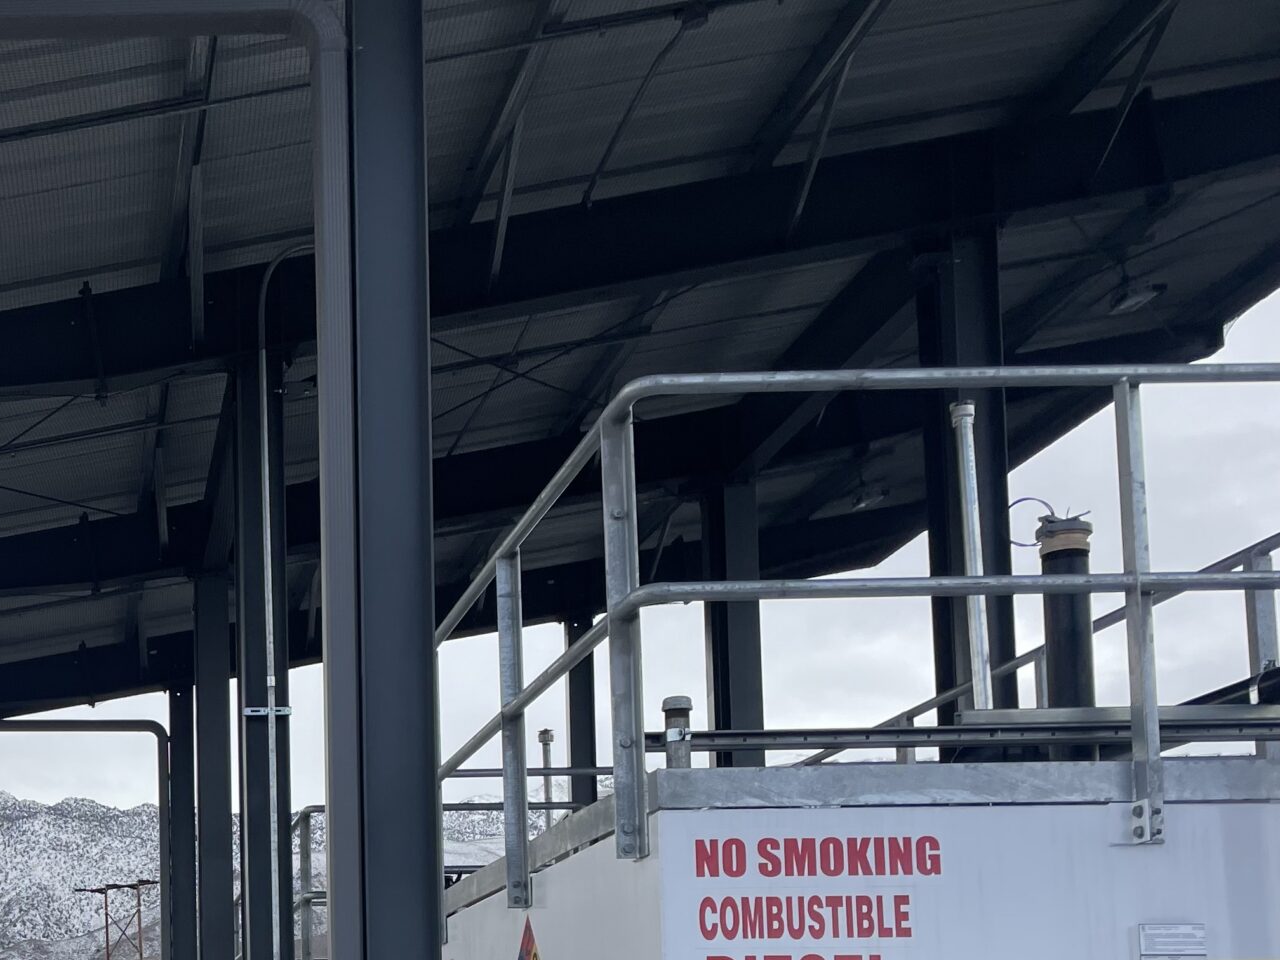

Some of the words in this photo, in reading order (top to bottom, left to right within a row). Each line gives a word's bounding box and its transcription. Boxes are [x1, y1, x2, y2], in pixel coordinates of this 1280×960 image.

[694, 837, 748, 878] NO
[756, 835, 943, 878] SMOKING
[698, 894, 913, 941] COMBUSTIBLE
